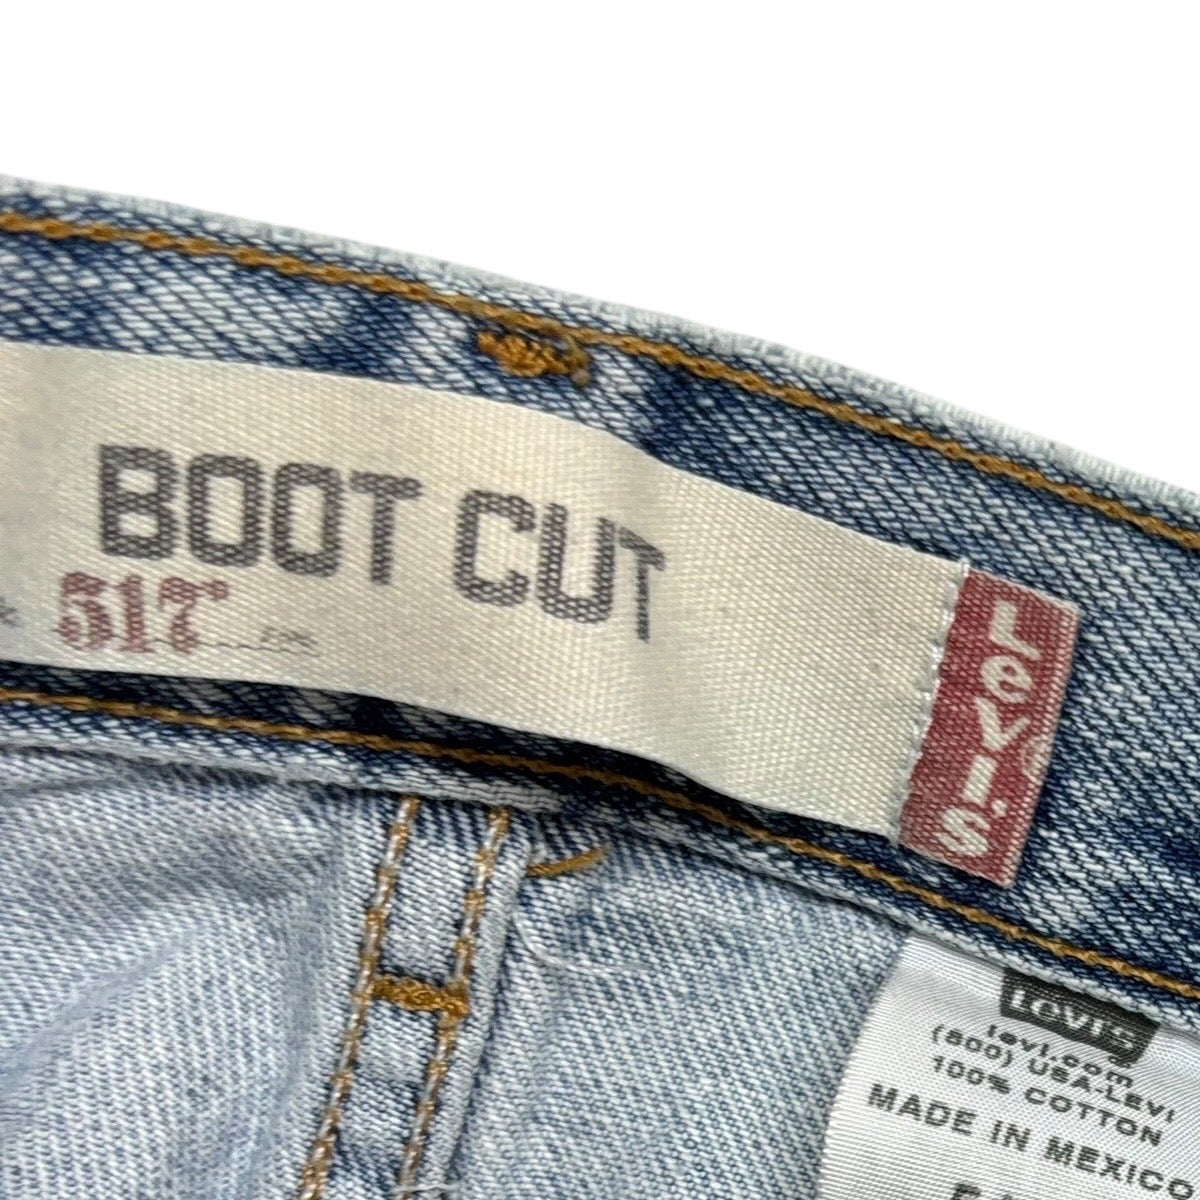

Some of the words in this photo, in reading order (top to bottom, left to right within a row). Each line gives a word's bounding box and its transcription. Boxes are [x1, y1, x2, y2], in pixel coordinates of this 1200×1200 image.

[98, 443, 422, 586] BOOT
[453, 487, 667, 644] CUT
[931, 1022, 1013, 1068] (800)
[867, 1083, 977, 1134] MADE
[990, 1119, 1030, 1153] IN
[1045, 1137, 1195, 1200] MEXICO
[932, 1055, 1012, 1095] 100%
[1024, 1085, 1163, 1147] COTTON
